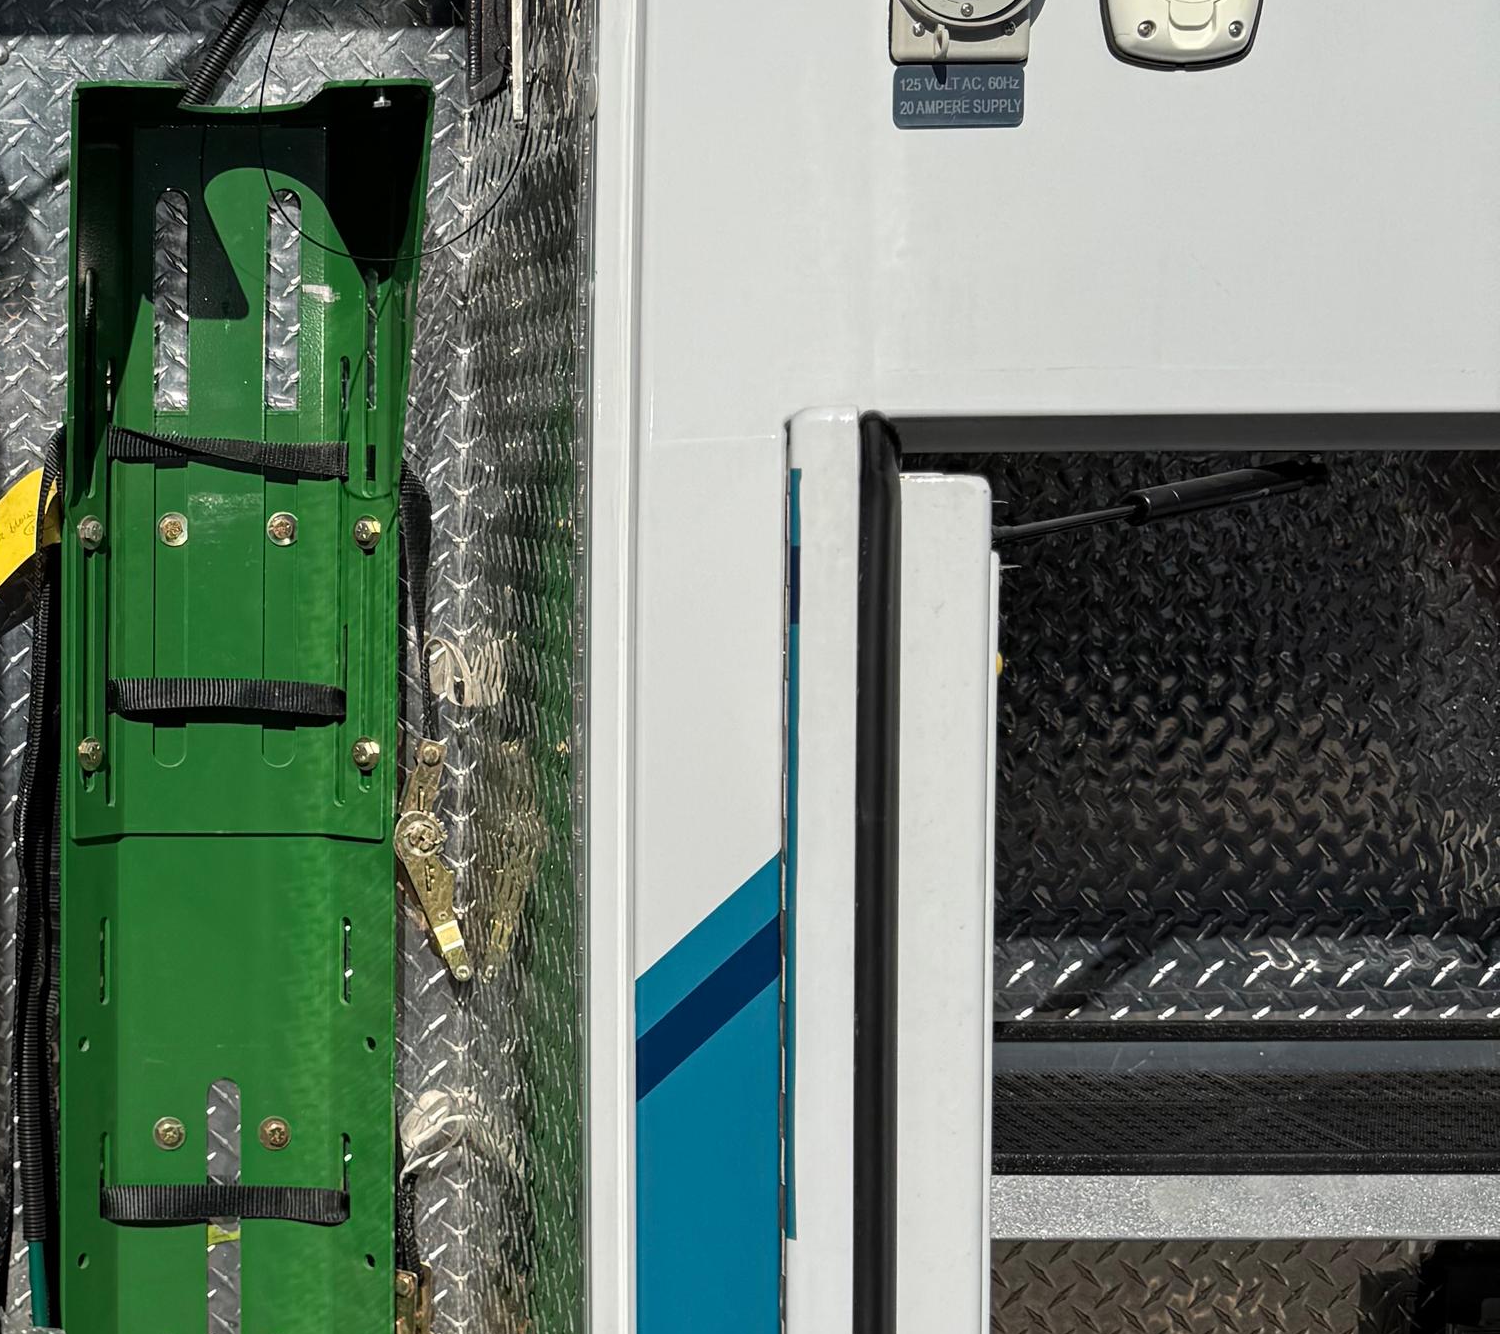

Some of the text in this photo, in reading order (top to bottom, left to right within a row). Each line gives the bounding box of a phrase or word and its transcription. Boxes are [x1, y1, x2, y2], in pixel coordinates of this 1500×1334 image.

[900, 77, 921, 91] 125
[962, 76, 985, 92] AC,
[988, 75, 1020, 90] 60Hz
[900, 98, 1022, 115] 20 AMPERE SUPPLY
